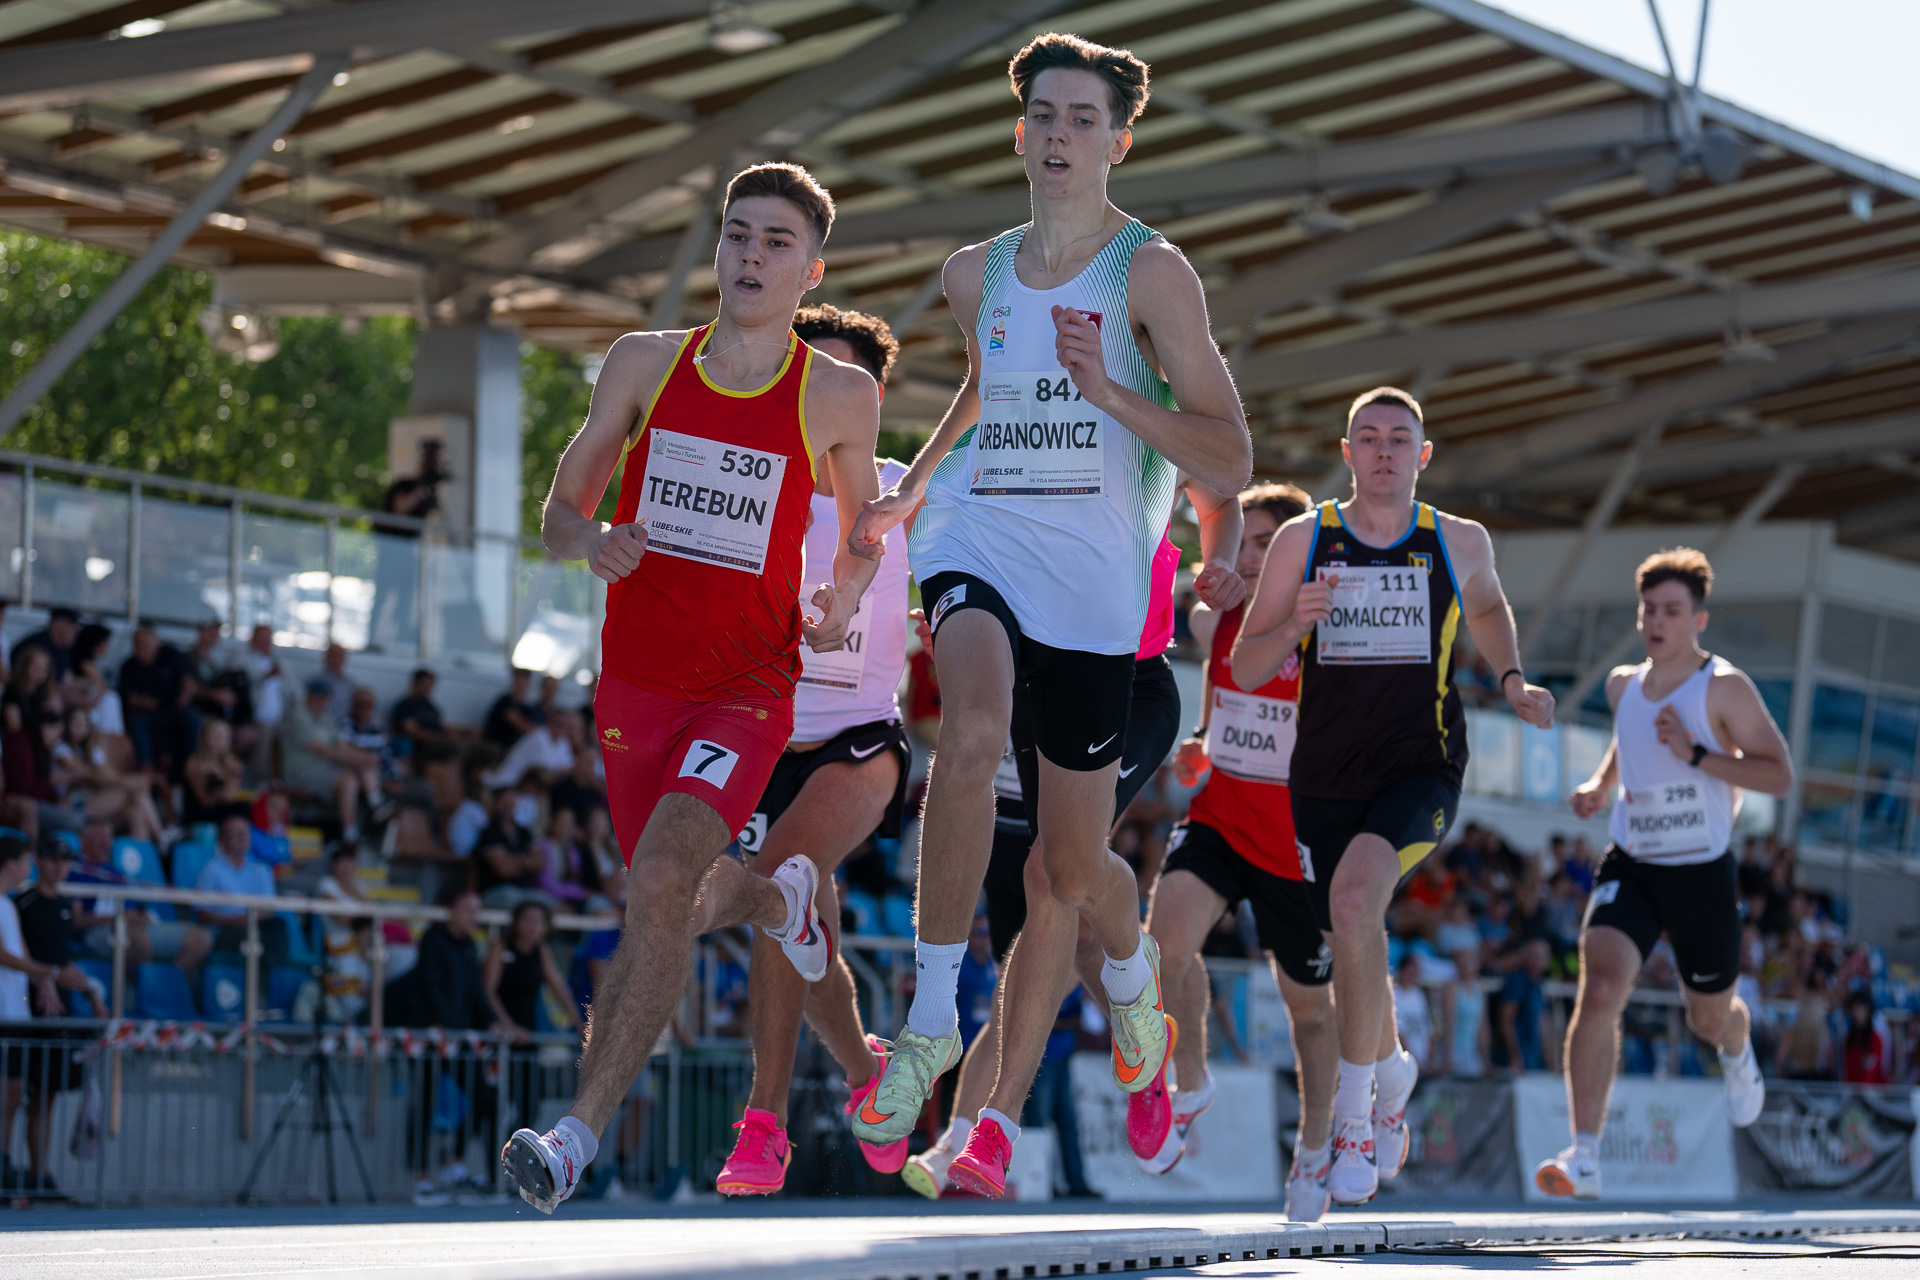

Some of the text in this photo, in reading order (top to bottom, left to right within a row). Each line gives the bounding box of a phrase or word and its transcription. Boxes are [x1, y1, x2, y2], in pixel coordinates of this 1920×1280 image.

[978, 421, 1098, 450] URBANOWICZ
[666, 448, 681, 456] Sportu
[684, 452, 706, 461] Turystyki
[668, 442, 697, 453] Ministerstwo
[719, 449, 772, 481] 530
[983, 468, 1023, 476] LUBELSKIE
[981, 477, 999, 485] 2024
[648, 476, 768, 526] TEREBUN
[649, 528, 669, 539] 2024
[651, 520, 694, 536] LUBELSKIE
[1380, 573, 1418, 591] 111
[935, 591, 955, 619] 6
[1257, 703, 1293, 723] 319
[1222, 725, 1277, 753] DUDA
[692, 743, 727, 775] 7
[1664, 783, 1697, 804] 298
[737, 816, 757, 846] 5
